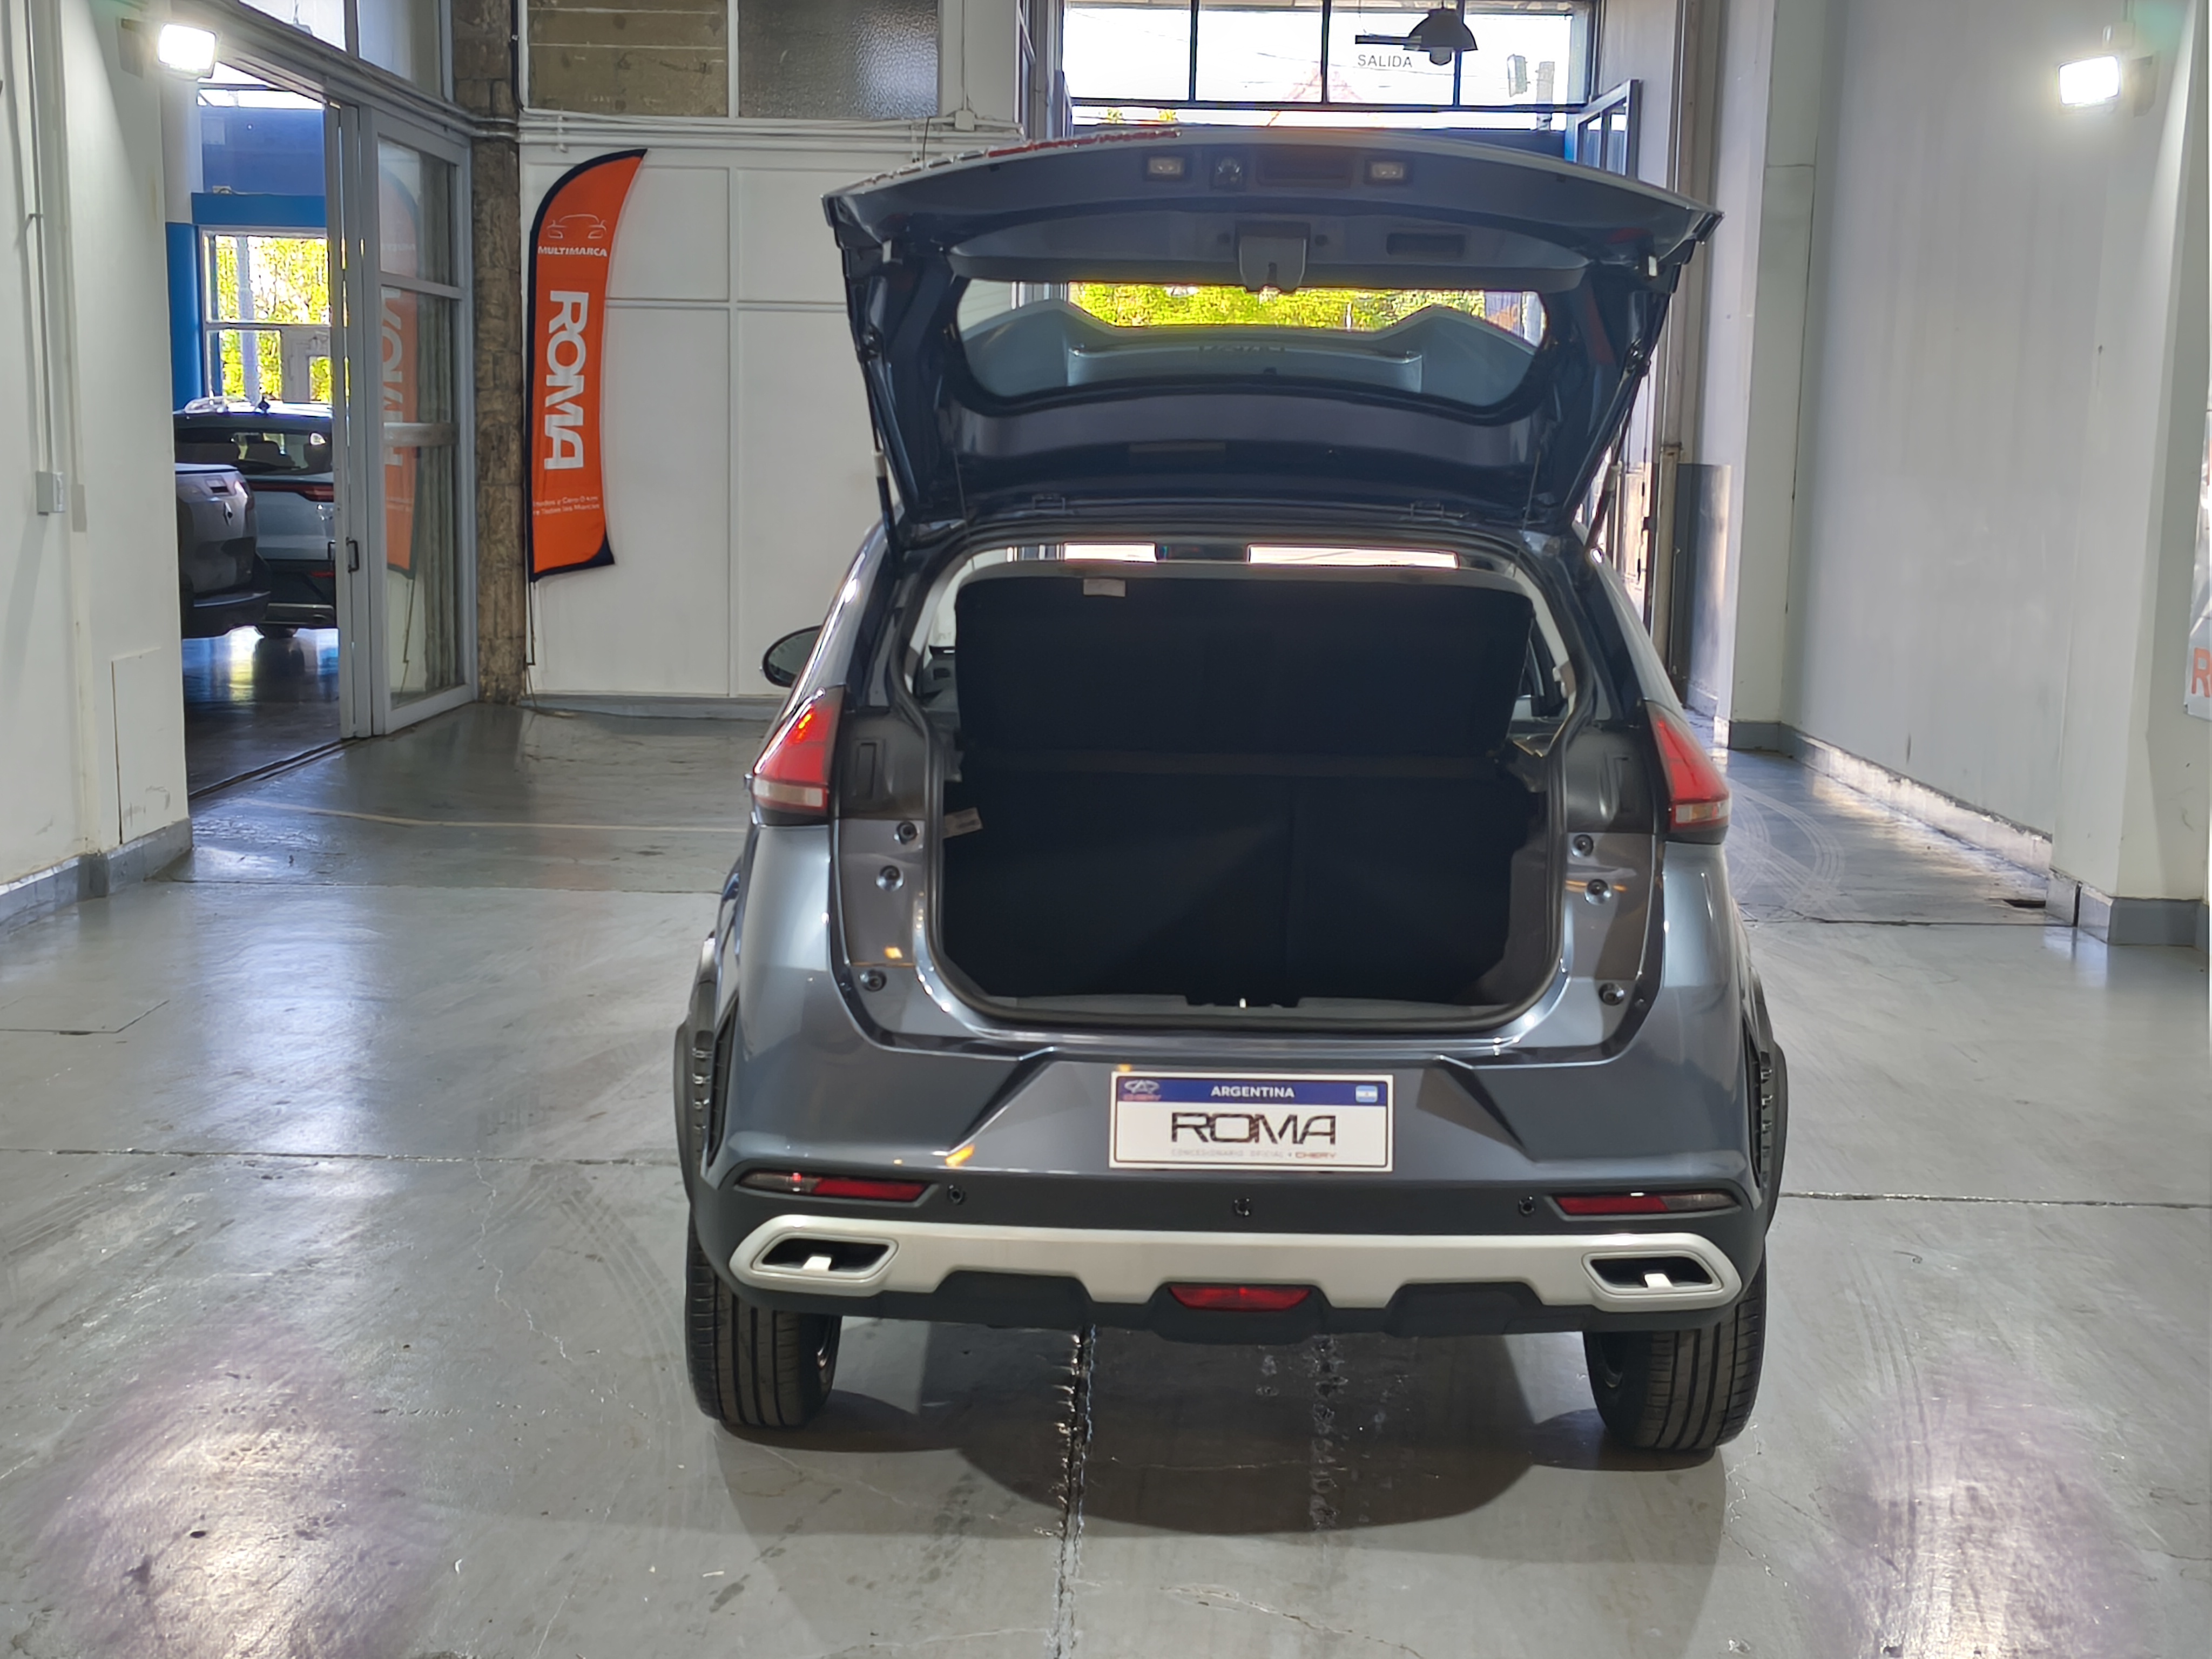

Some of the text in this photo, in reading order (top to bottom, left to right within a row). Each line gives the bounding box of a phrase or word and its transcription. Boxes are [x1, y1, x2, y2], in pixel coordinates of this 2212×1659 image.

[1358, 54, 1412, 68] SALIDA
[537, 246, 608, 257] MULTIMARCA
[544, 290, 589, 470] ROMA
[2191, 647, 2212, 698] R
[1210, 1085, 1295, 1098] ARGENTINA
[1172, 1112, 1336, 1145] ROMA
